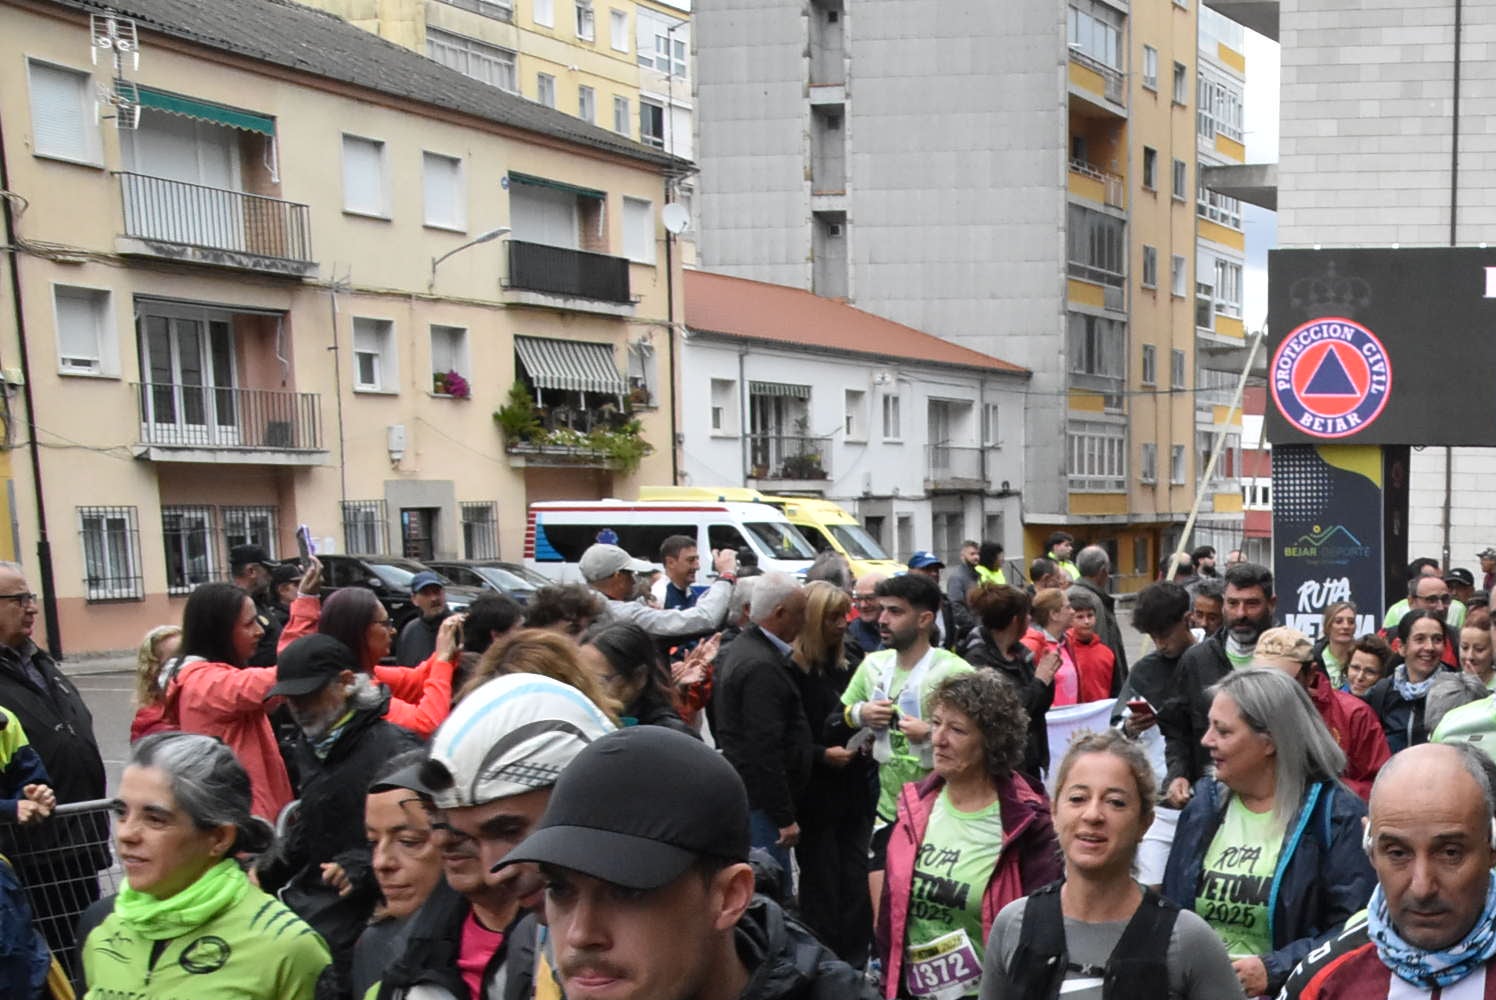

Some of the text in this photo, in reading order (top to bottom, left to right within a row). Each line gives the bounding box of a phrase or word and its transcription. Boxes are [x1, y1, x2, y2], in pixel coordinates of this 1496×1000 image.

[1276, 323, 1387, 394] PROTECCION CIVIL
[1204, 902, 1257, 929] 2025
[912, 953, 971, 989] 1372
